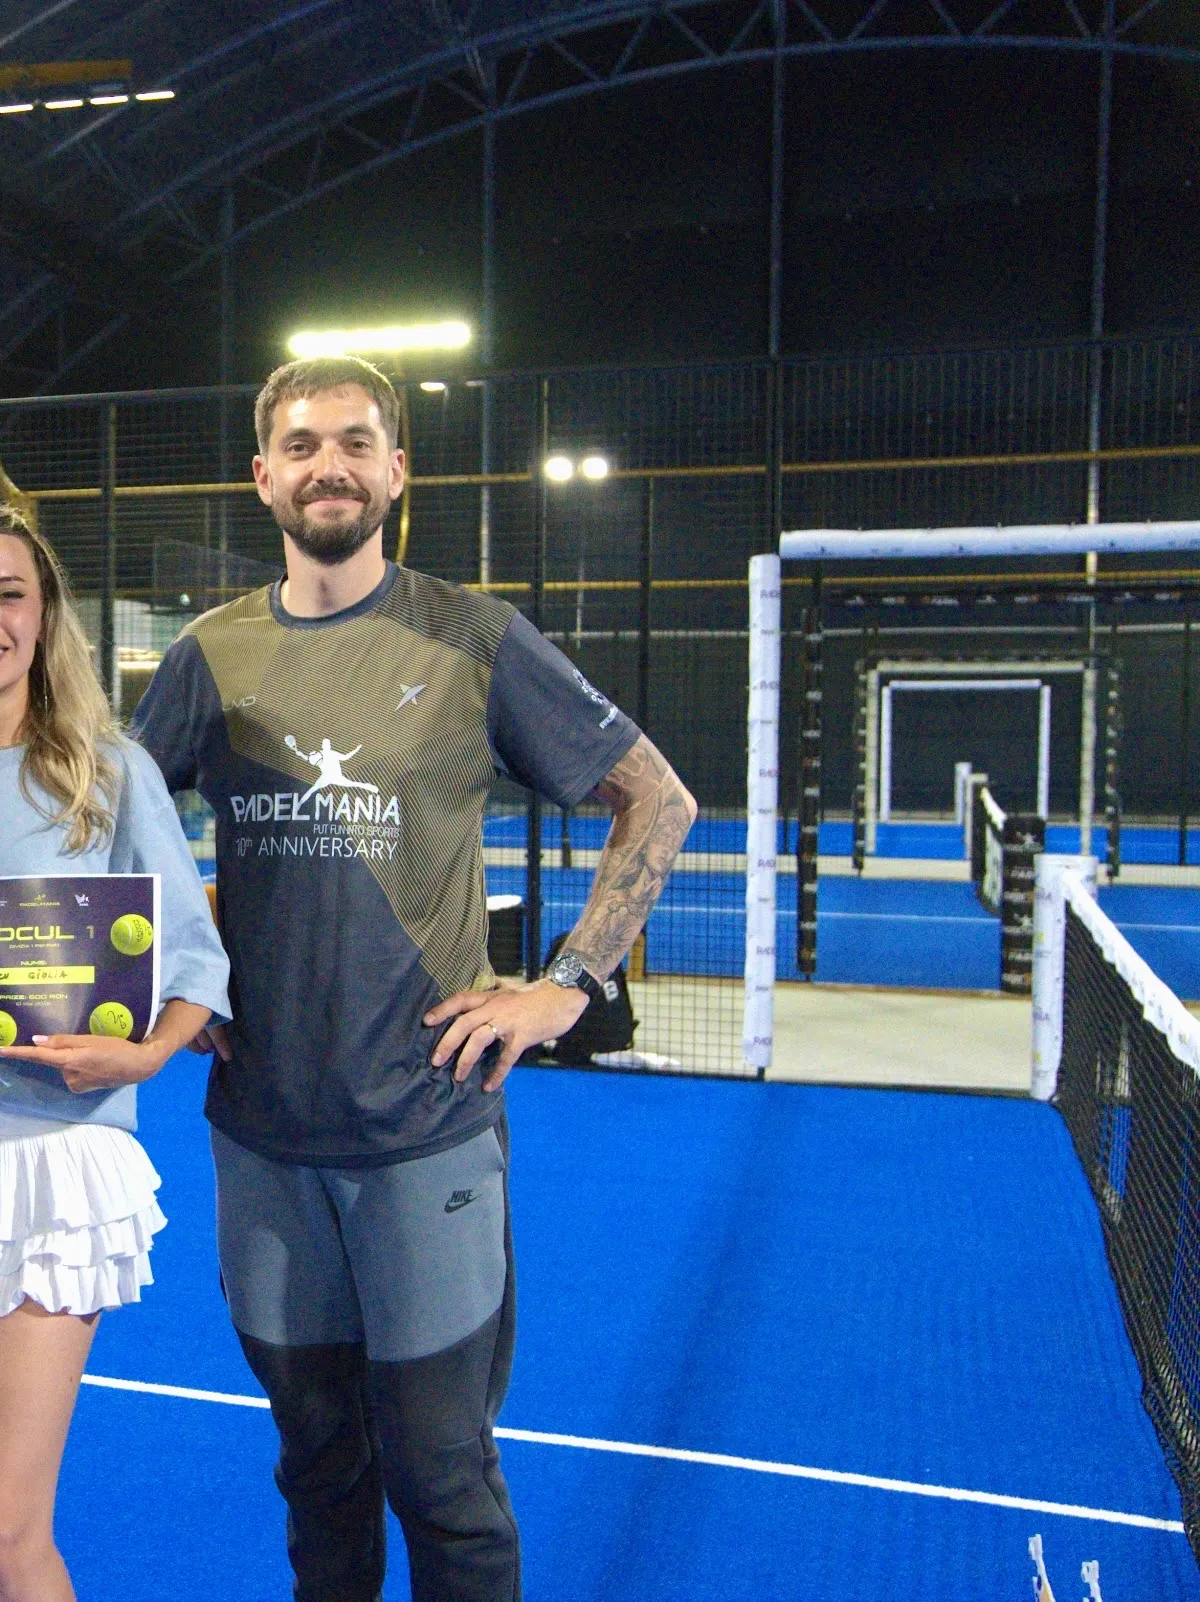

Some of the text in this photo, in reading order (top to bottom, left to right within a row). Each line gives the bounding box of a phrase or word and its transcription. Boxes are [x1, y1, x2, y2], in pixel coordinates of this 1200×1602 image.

[230, 792, 400, 825] PADEL MANIA
[313, 824, 329, 834] PUT
[330, 825, 345, 835] FUN
[366, 826, 400, 838] SPORTS
[236, 836, 398, 860] 10th ANNIVERSARY
[86, 925, 95, 939] 1
[450, 1189, 474, 1202] NIKE
